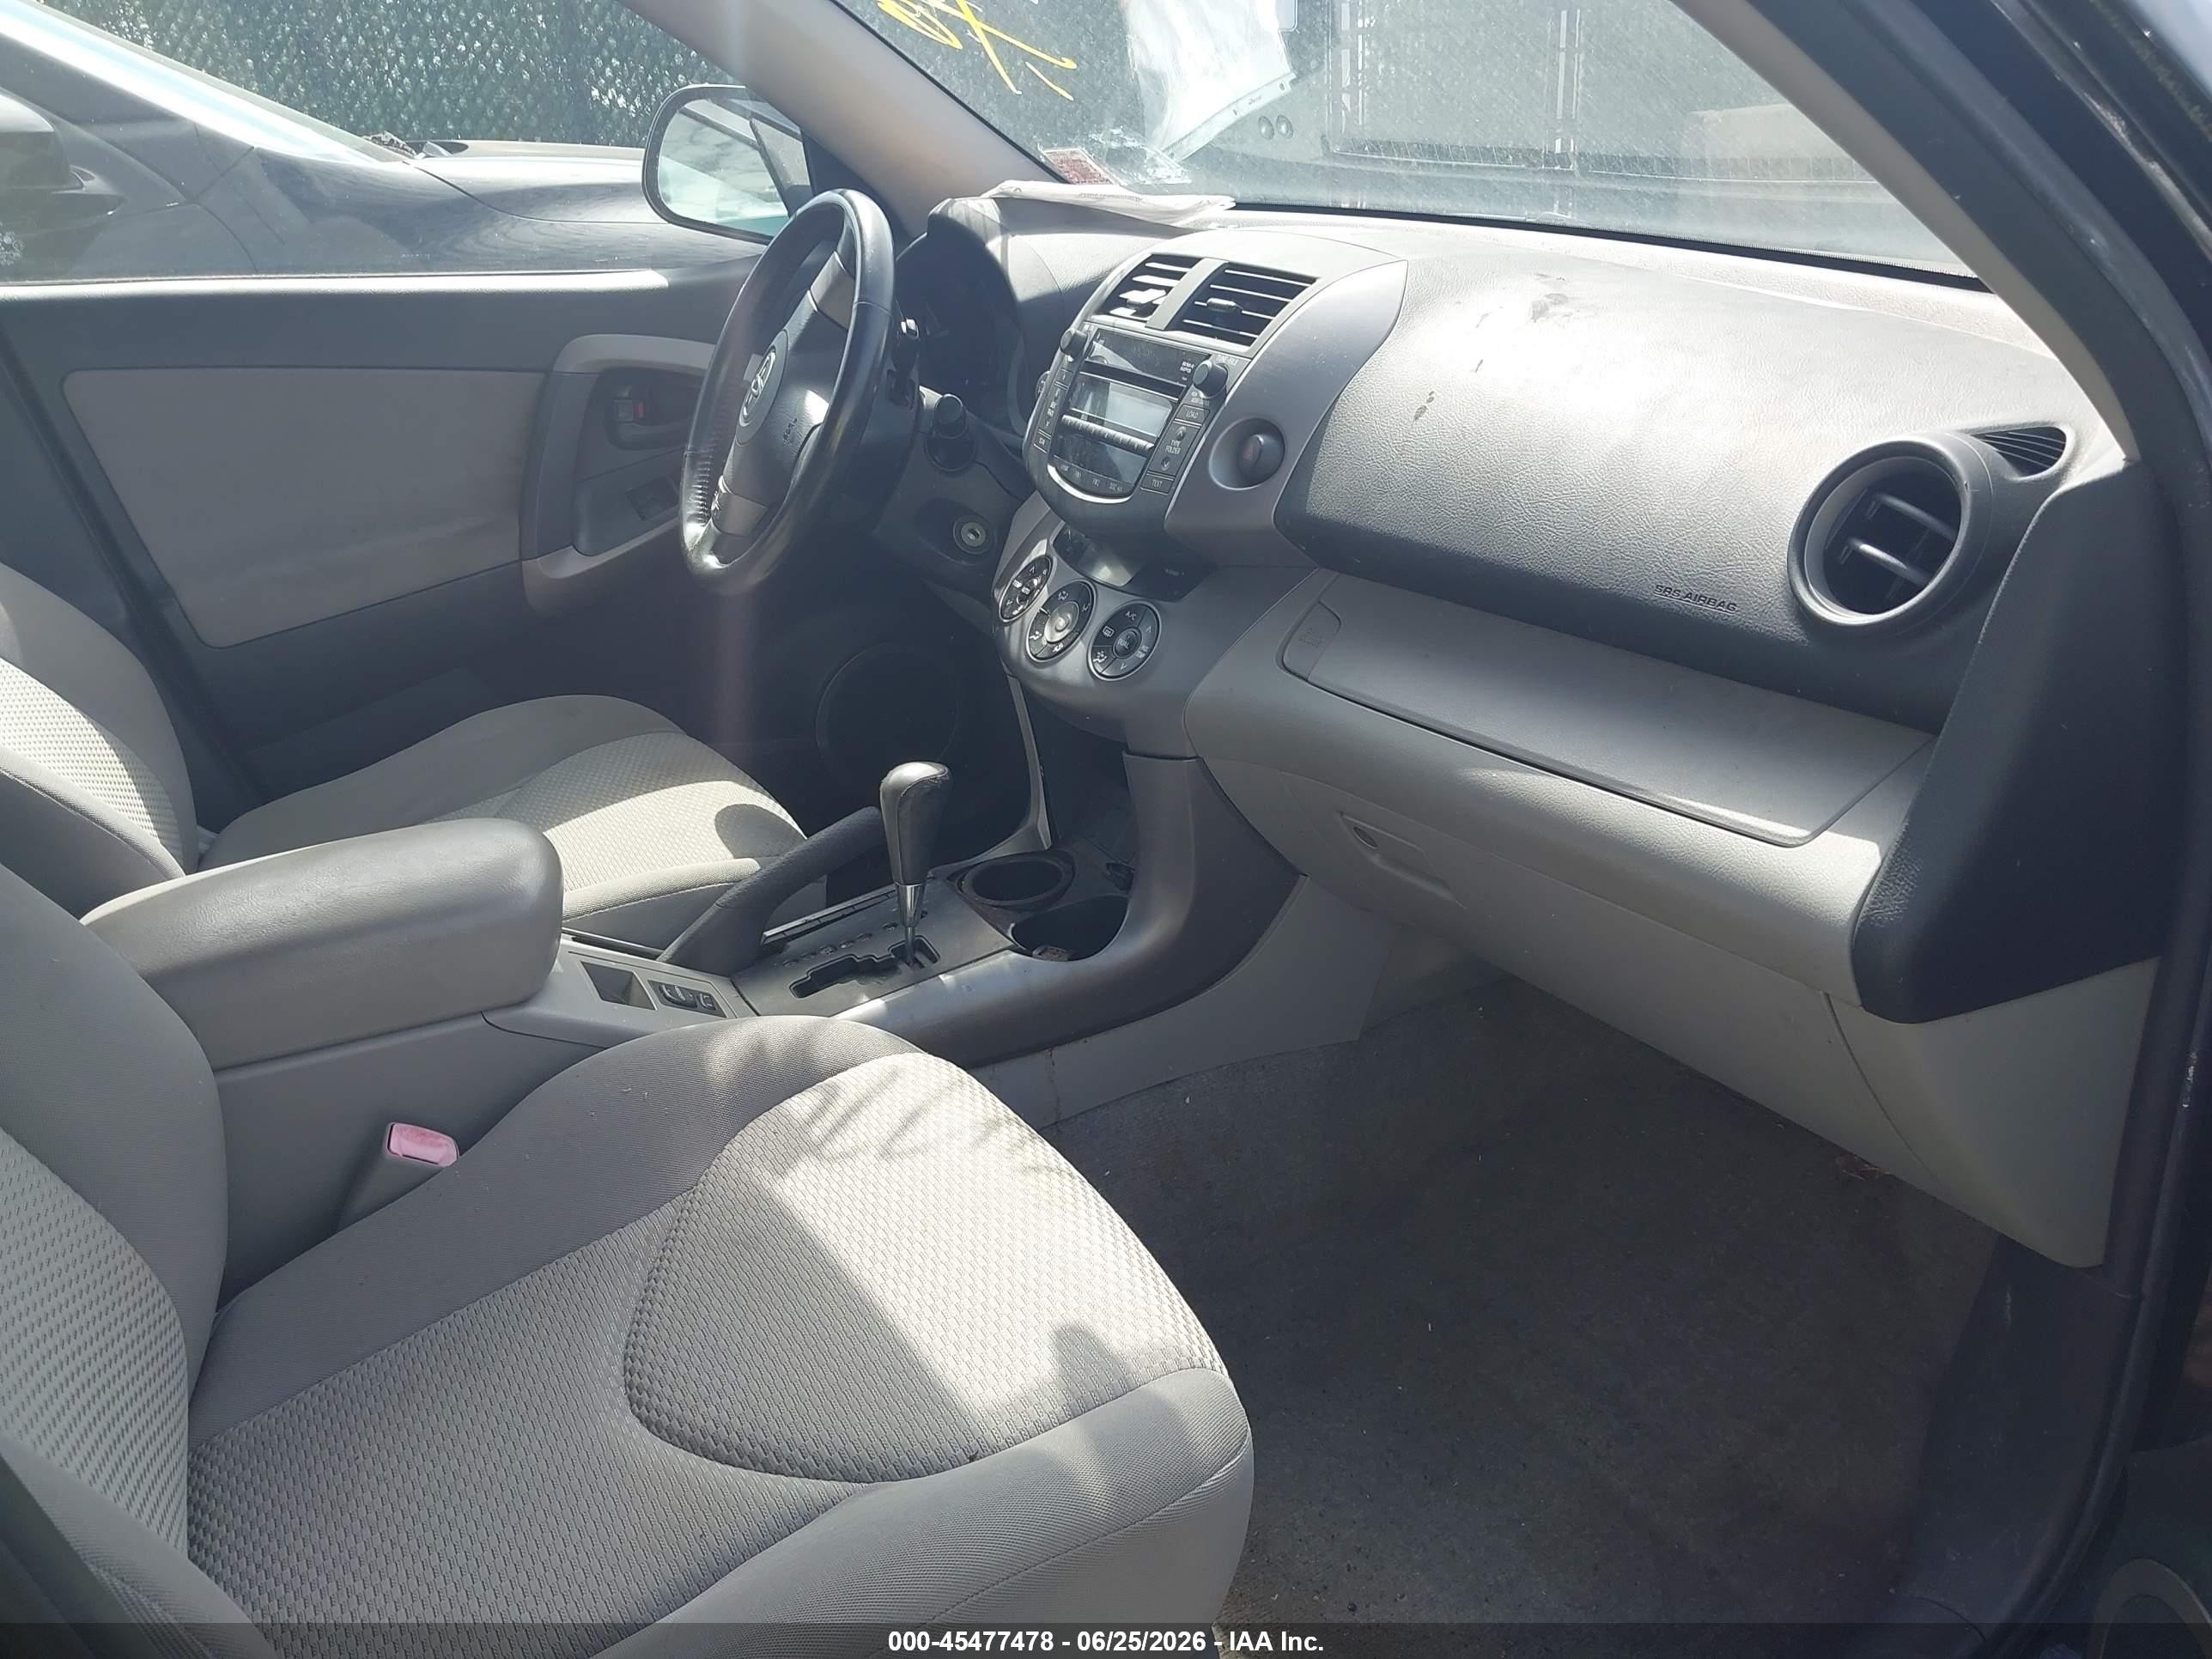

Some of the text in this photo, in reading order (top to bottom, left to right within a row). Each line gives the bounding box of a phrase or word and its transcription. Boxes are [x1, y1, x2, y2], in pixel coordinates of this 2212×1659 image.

[1186, 411, 1199, 420] LOAD
[1165, 445, 1182, 455] FOLDER
[1152, 479, 1164, 488] TEXT
[1654, 584, 1737, 612] SRS AIRBAG
[1125, 611, 1137, 621] A/C
[1117, 638, 1130, 649] DUAL
